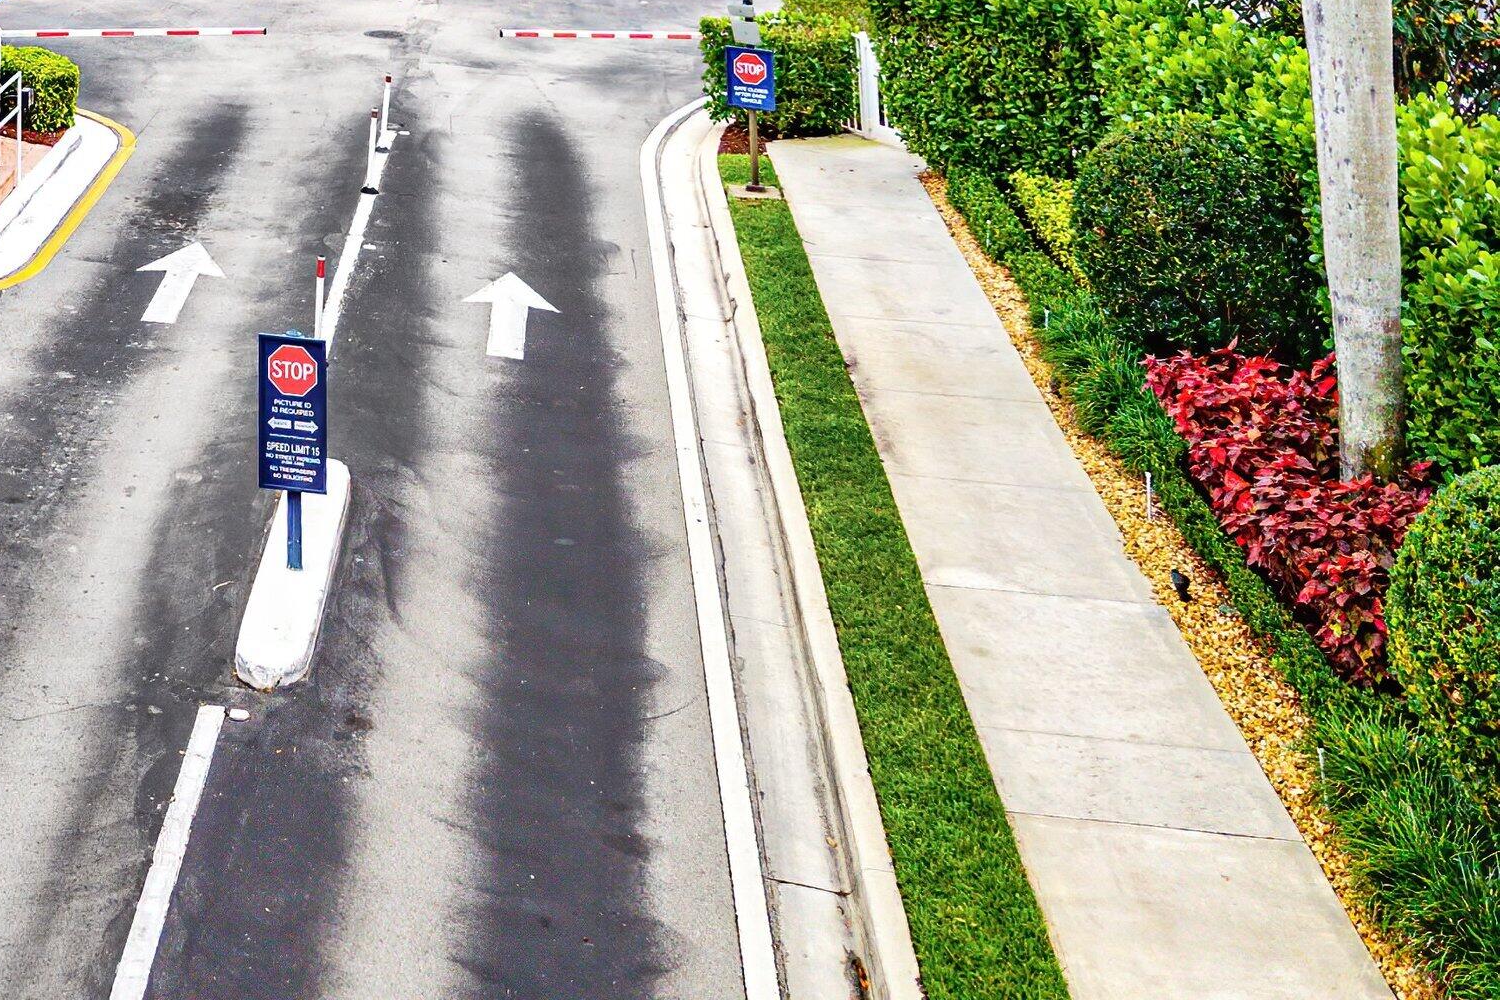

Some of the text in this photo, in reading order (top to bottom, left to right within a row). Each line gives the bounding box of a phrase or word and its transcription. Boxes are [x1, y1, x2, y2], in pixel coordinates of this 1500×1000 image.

[736, 62, 764, 76] STOP
[272, 360, 314, 380] STOP
[274, 399, 303, 408] PICTURE
[279, 407, 315, 417] REQUIRED
[266, 441, 320, 456] SPEED LIMIT 15
